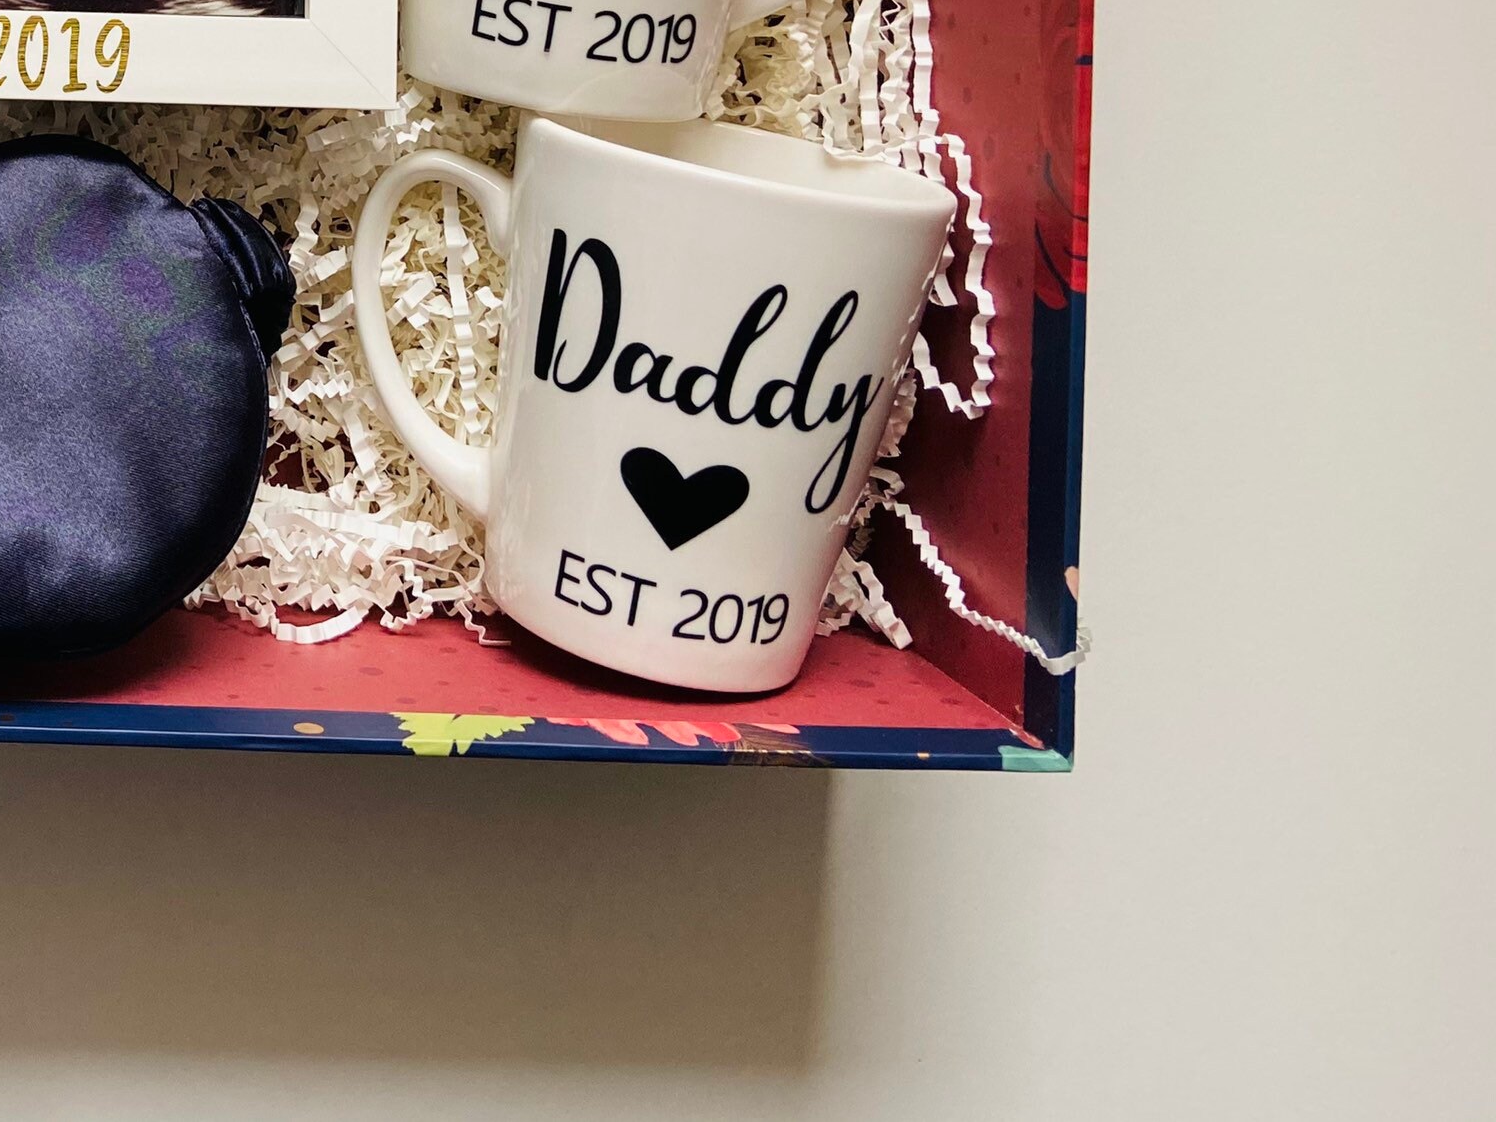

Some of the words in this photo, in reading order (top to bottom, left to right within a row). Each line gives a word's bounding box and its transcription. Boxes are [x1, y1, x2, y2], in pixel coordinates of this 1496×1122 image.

[585, 10, 697, 65] 2019
[534, 227, 884, 514] Daddy
[553, 548, 658, 627] EST
[671, 588, 791, 645] 2019
